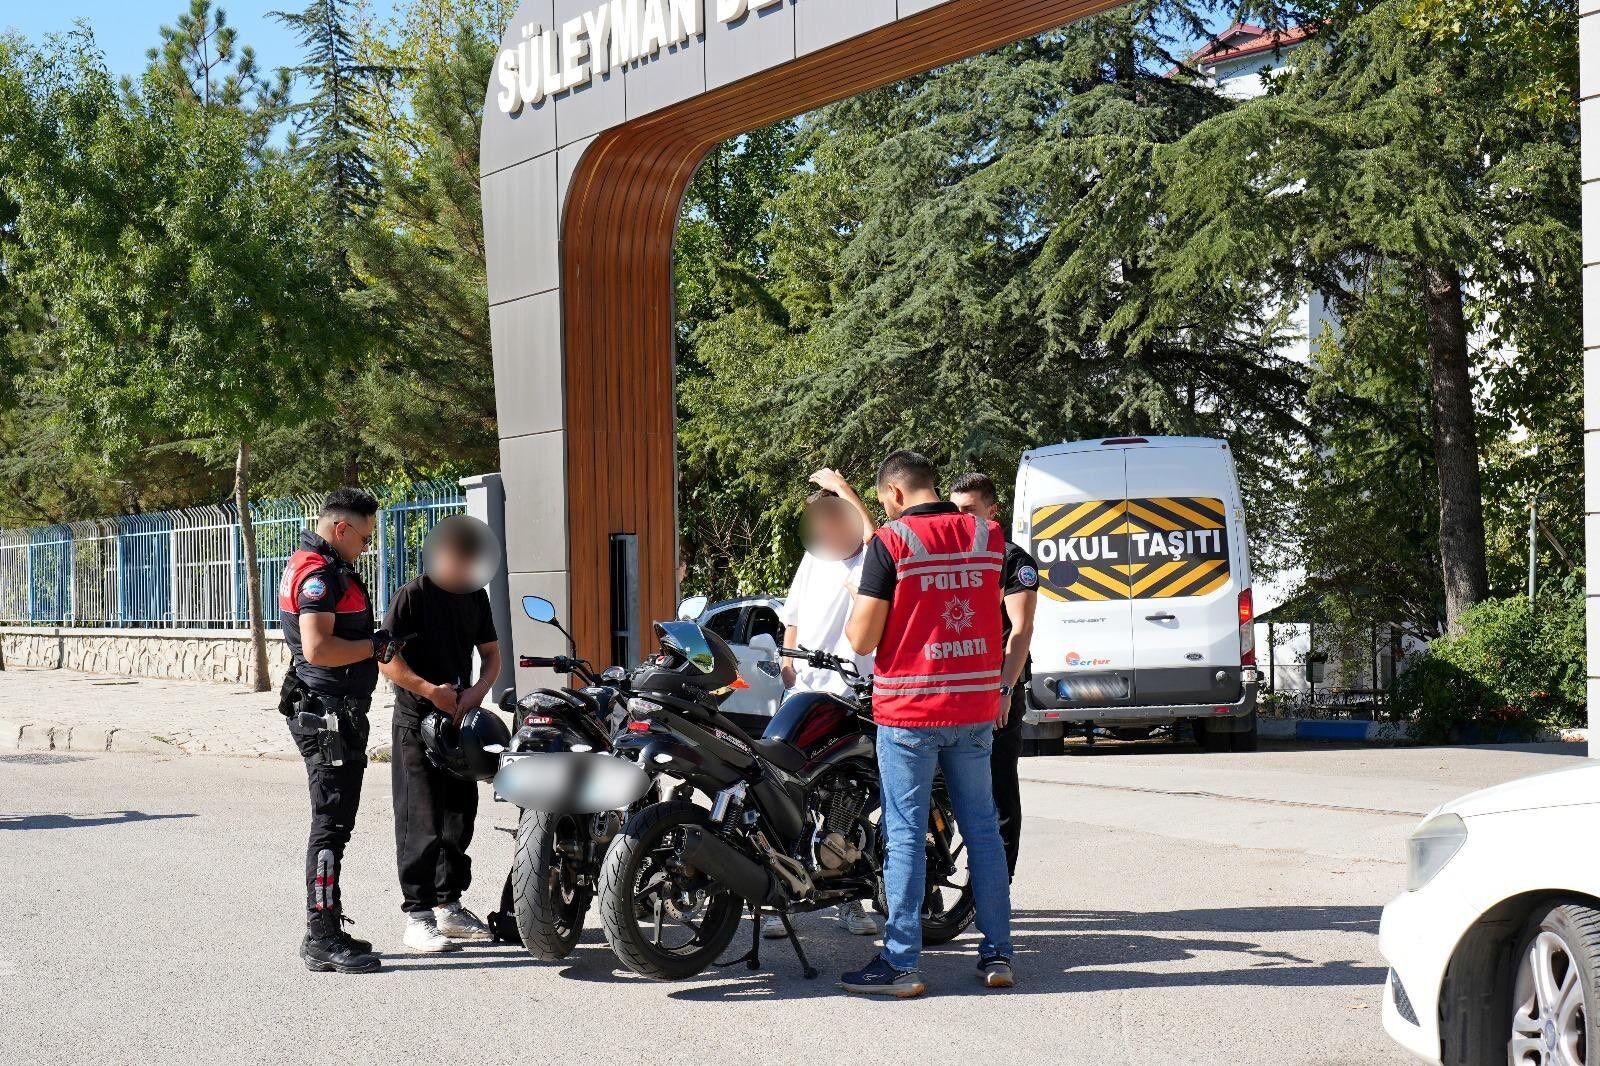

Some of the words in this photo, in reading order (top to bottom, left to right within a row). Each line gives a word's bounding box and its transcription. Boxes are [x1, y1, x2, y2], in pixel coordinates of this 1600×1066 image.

[497, 0, 705, 113] SÜLEYMAN
[1037, 536, 1118, 563] OKUL
[1132, 529, 1221, 561] TAŞITI
[924, 638, 987, 660] ISPARTA
